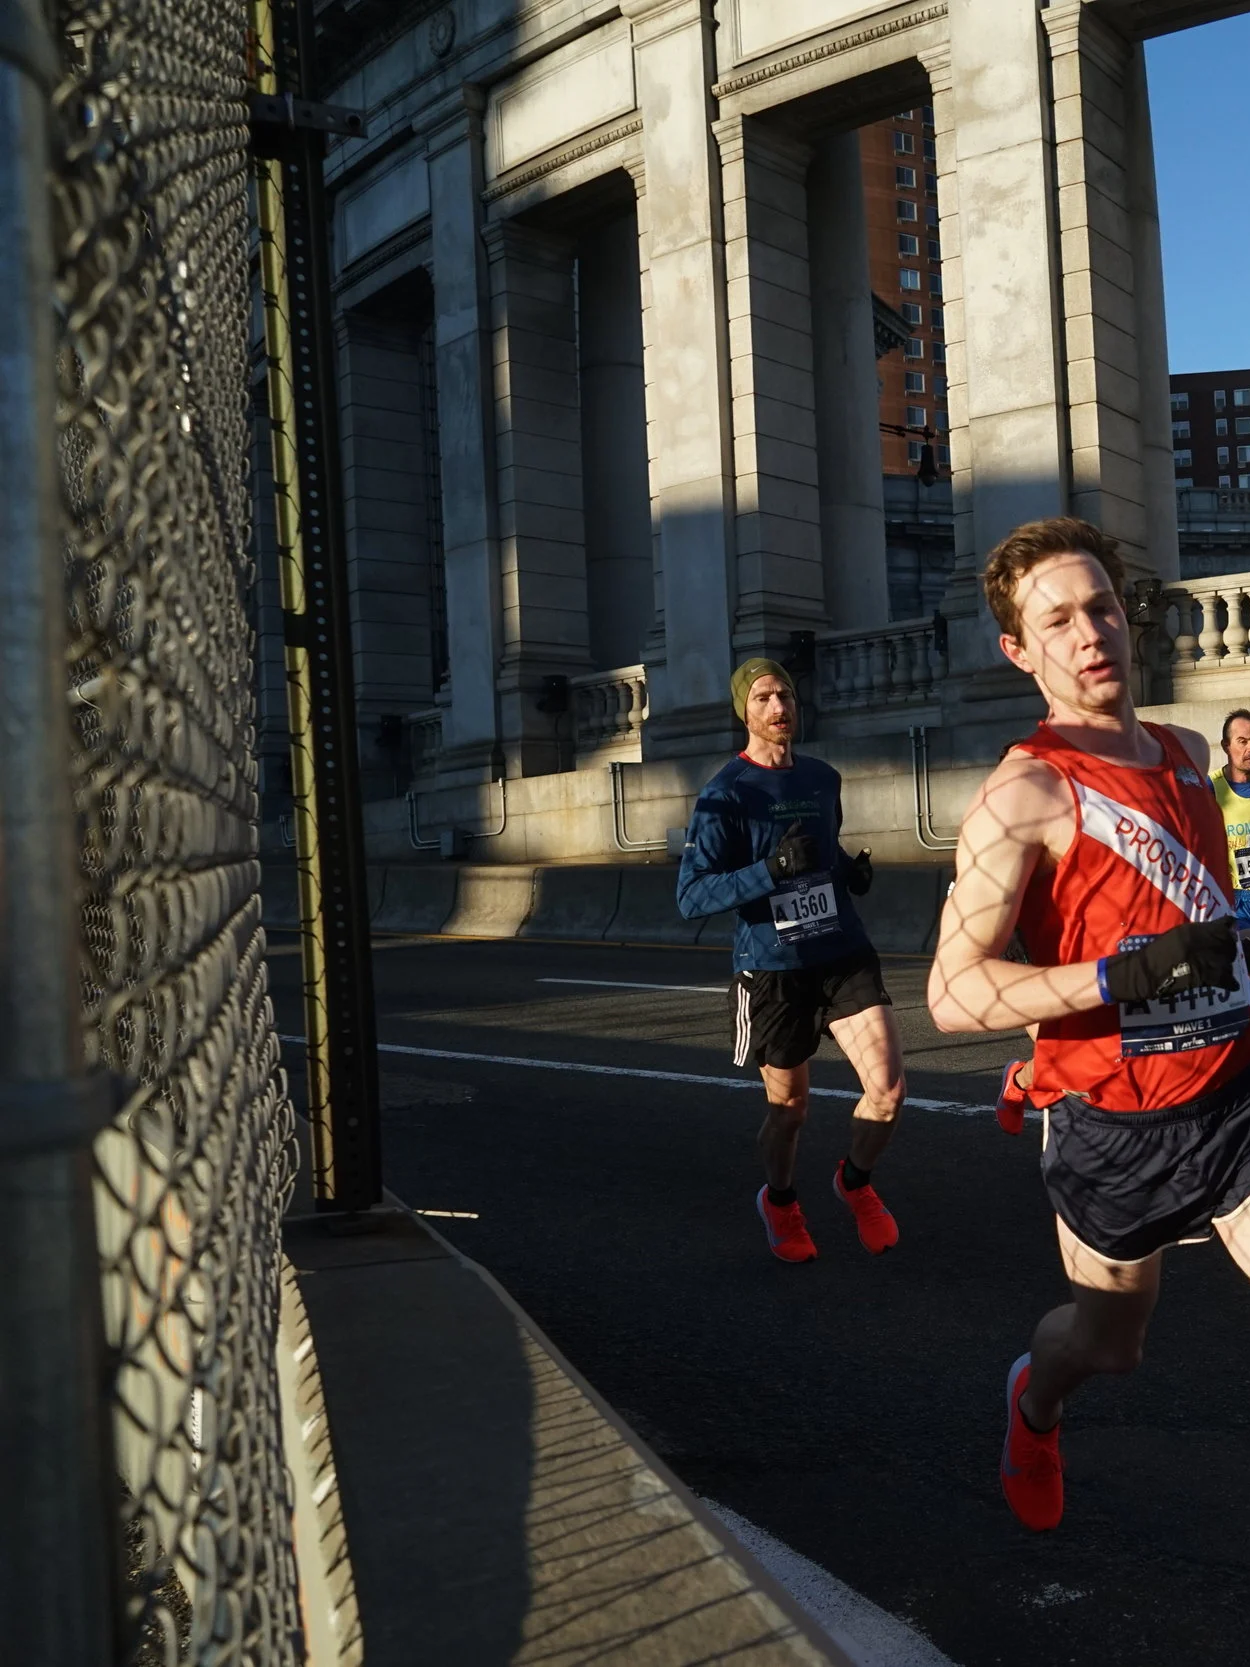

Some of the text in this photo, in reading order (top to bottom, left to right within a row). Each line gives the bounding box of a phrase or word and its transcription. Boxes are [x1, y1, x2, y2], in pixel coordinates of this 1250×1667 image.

[1115, 817, 1221, 919] PROSPECT
[1238, 861, 1245, 875] A
[776, 892, 828, 923] A 1560
[1173, 1018, 1212, 1035] WAVE 1
